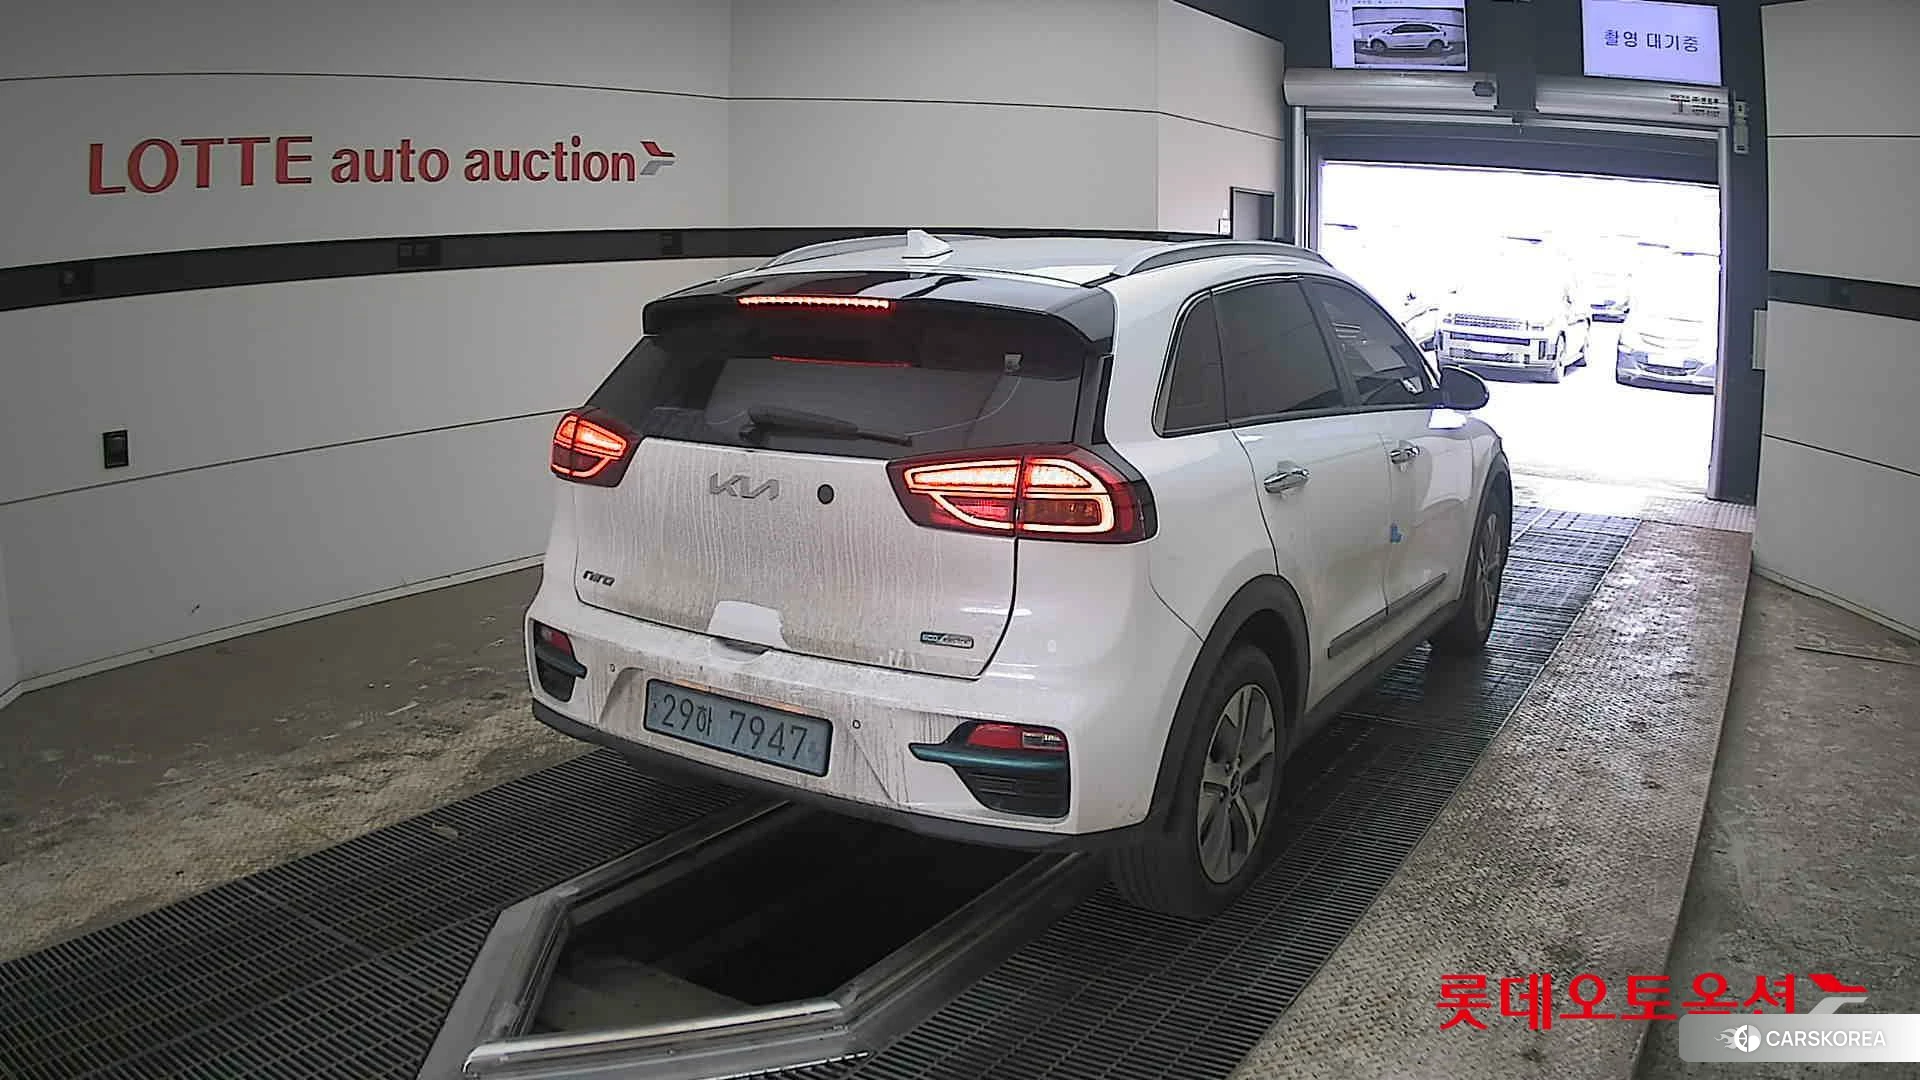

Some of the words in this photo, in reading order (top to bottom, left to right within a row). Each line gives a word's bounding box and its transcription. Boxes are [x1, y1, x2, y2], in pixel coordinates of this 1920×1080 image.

[1605, 30, 1638, 48] 촬영
[1646, 32, 1698, 52] 대기중
[89, 136, 312, 195] LOTTE
[330, 139, 449, 183] auto
[464, 136, 636, 183] auction
[709, 473, 779, 501] KIA
[662, 694, 713, 736] 29하
[729, 710, 808, 760] 7947
